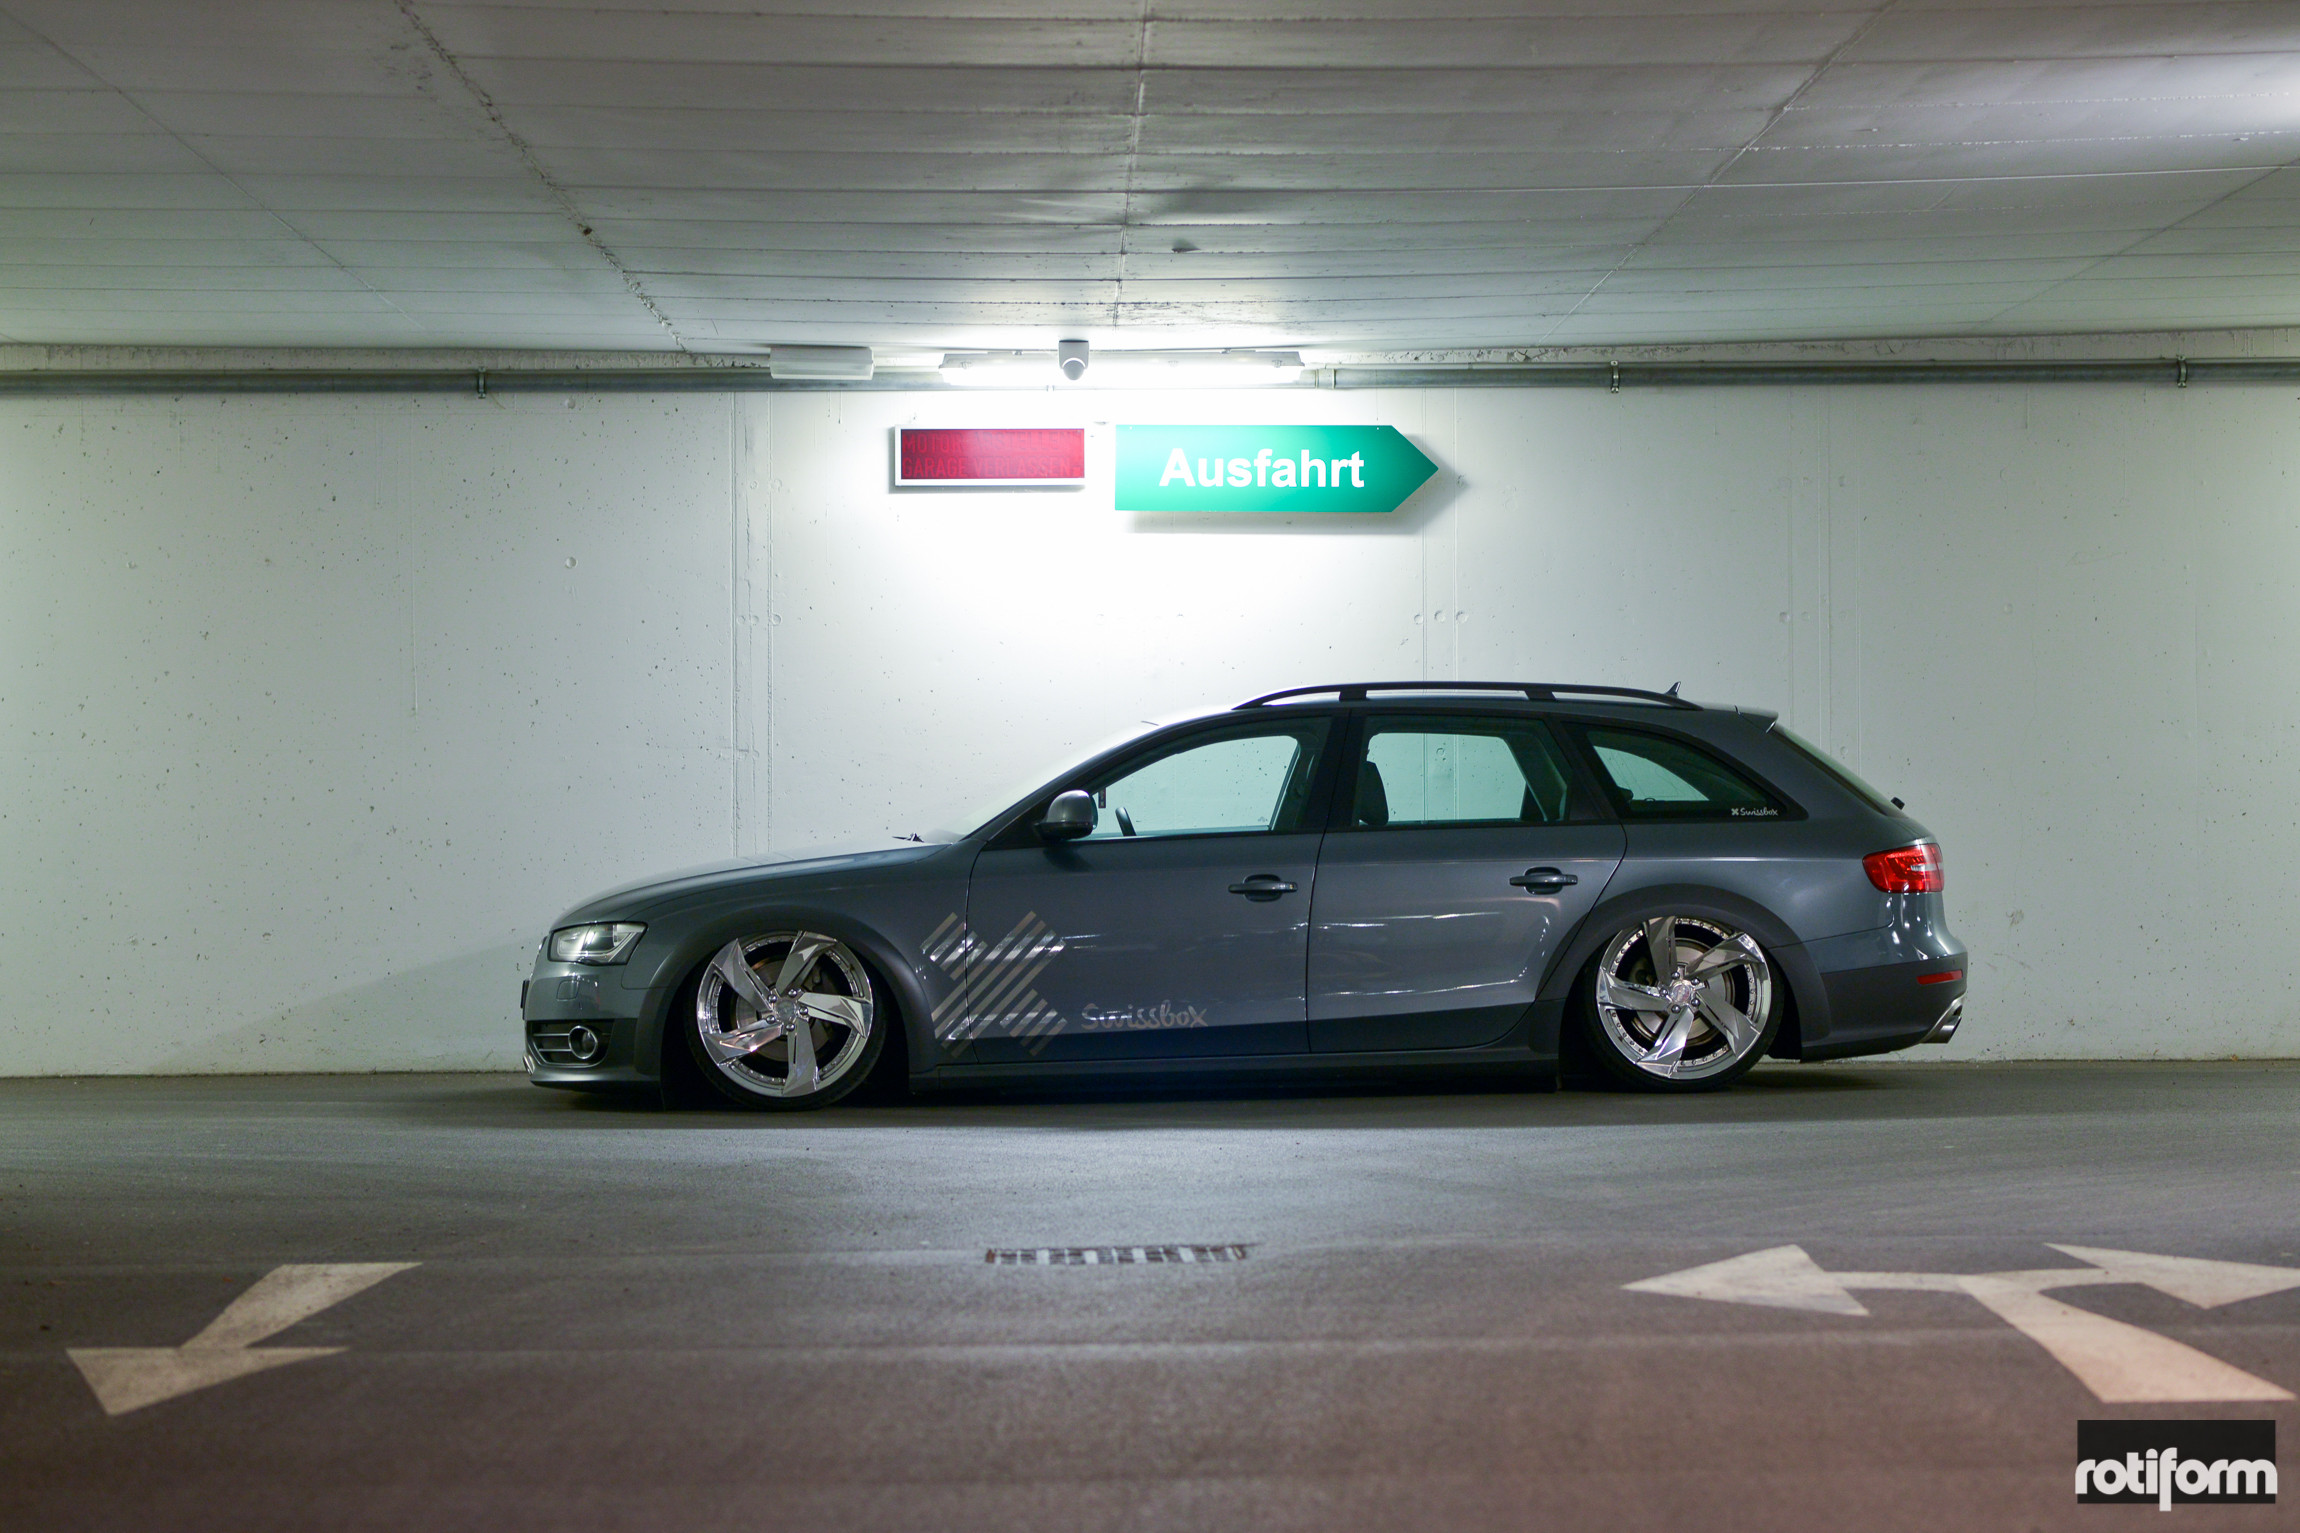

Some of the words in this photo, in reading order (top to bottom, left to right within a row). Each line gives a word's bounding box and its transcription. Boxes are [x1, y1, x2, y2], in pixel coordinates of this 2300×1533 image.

[902, 431, 964, 453] MOTOR
[902, 455, 968, 477] GARAGE
[1158, 447, 1365, 488] Ausfahrt
[1740, 807, 1778, 816] Swissbox
[1081, 999, 1208, 1030] Swissbox
